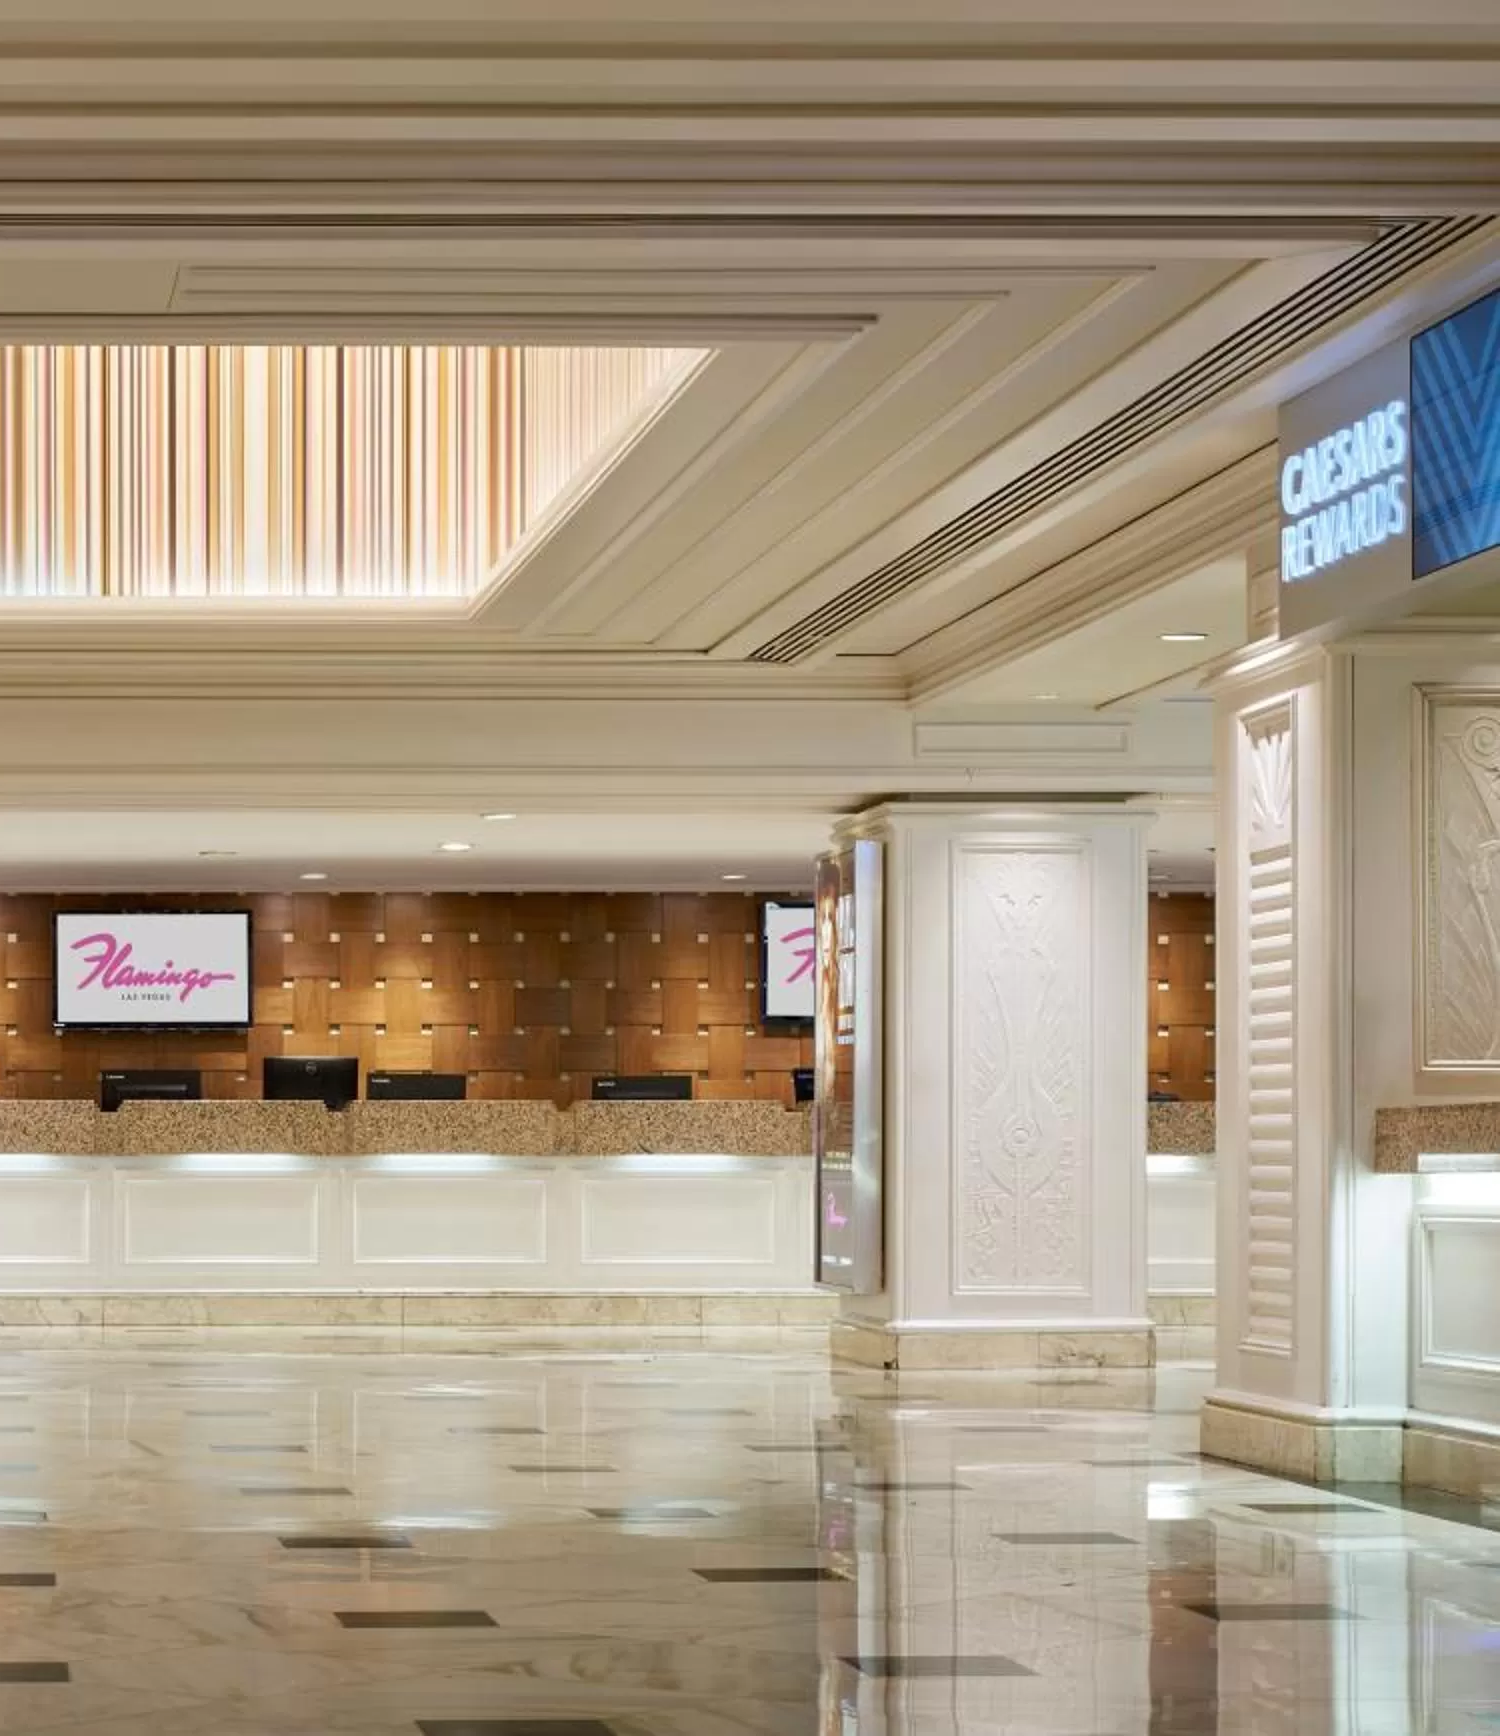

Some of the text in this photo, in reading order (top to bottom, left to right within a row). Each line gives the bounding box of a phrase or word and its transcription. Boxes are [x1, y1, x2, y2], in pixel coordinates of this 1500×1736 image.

[1281, 399, 1407, 516] CAESARS
[1281, 473, 1407, 583] REWARDS
[70, 932, 236, 1003] Flamingo
